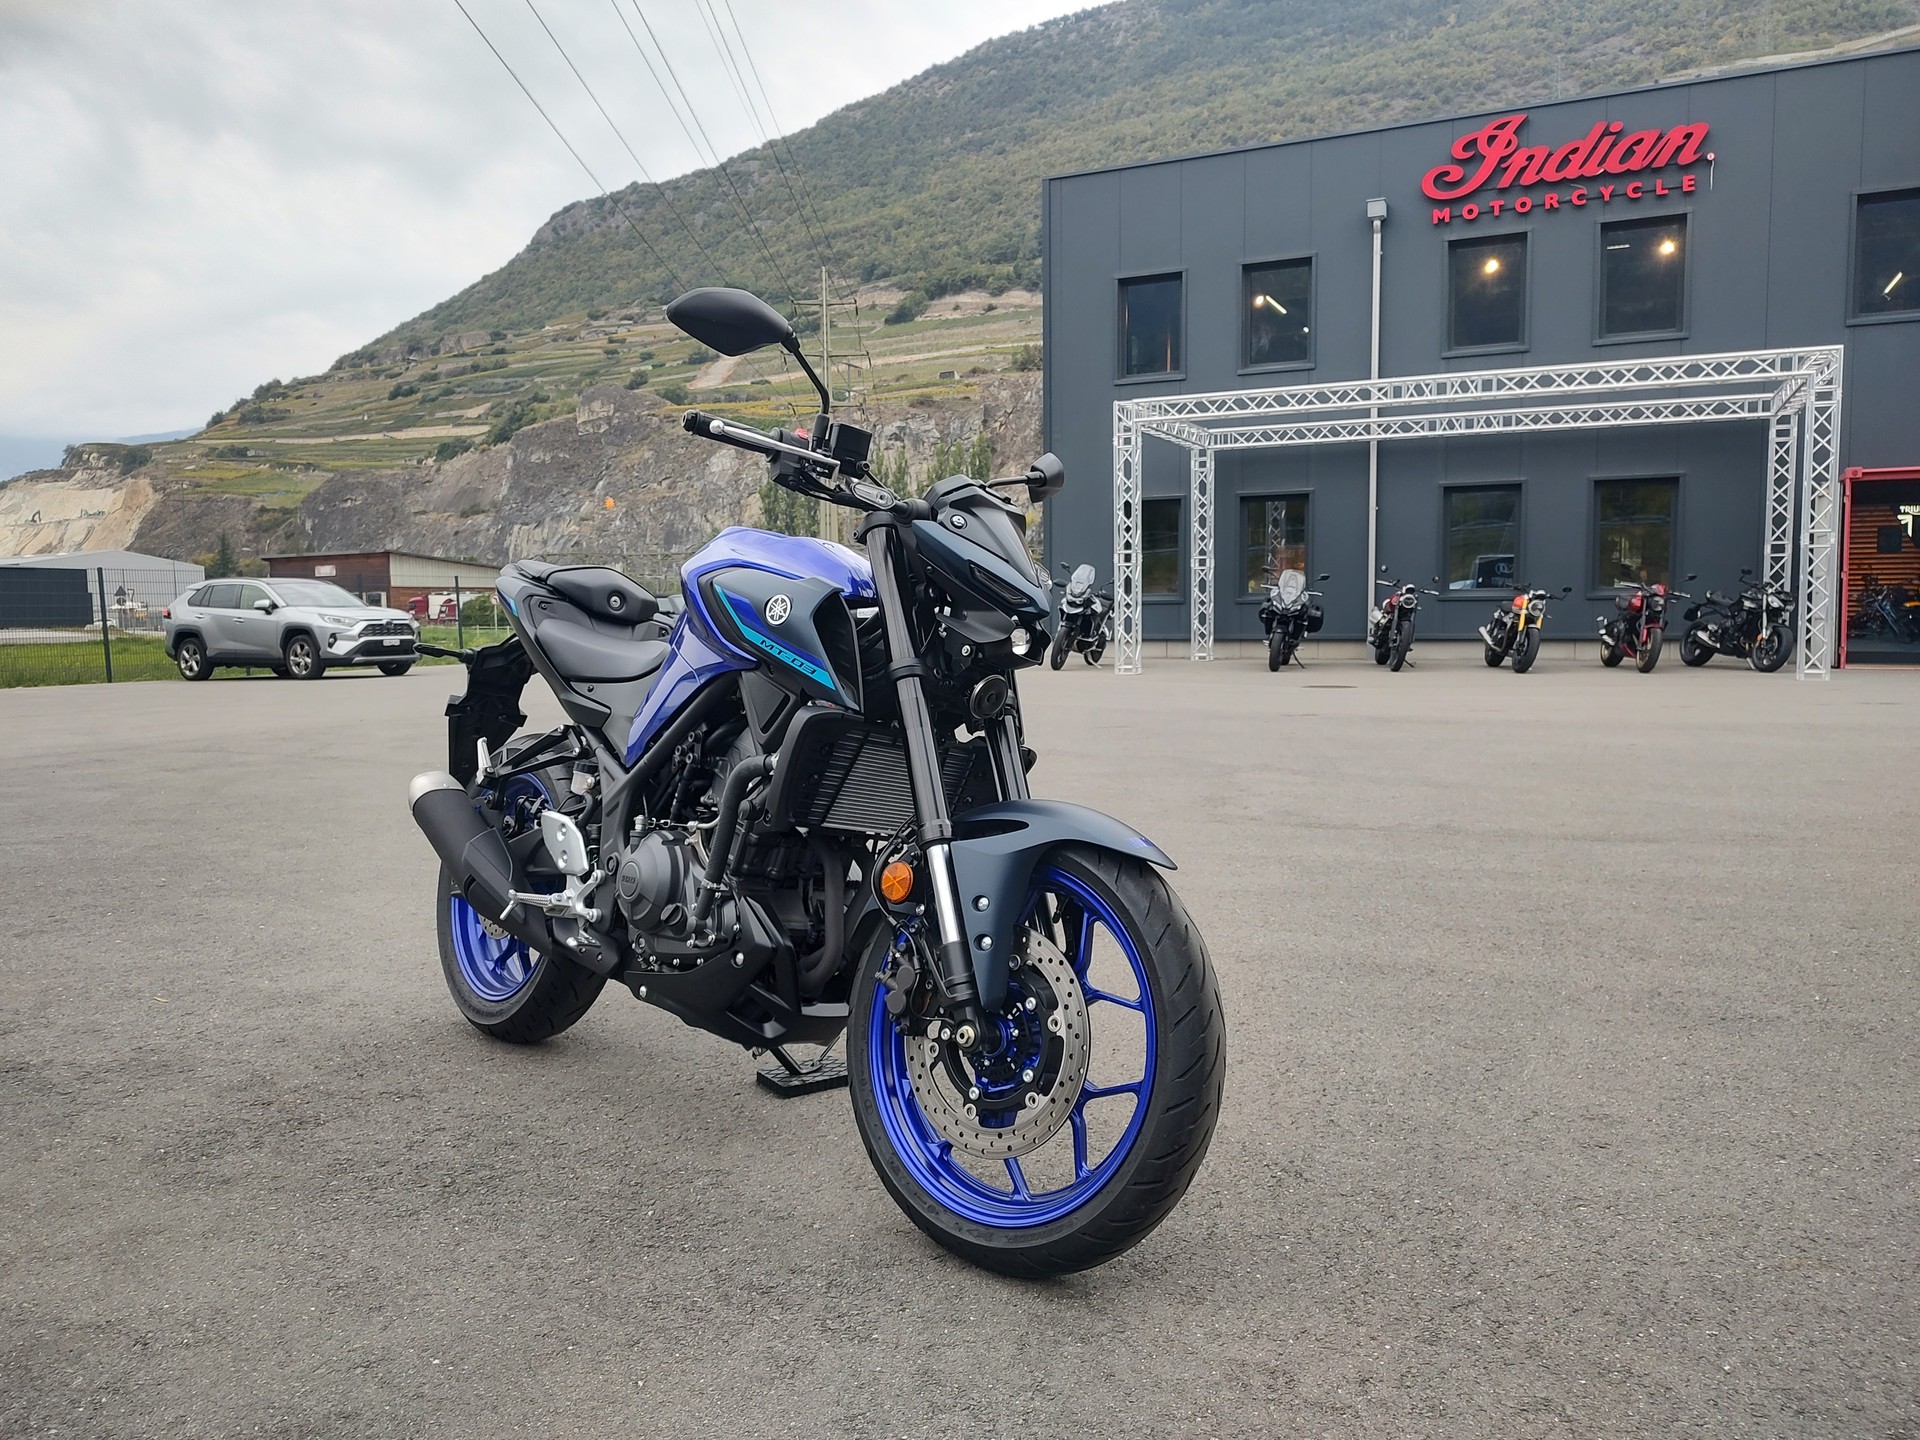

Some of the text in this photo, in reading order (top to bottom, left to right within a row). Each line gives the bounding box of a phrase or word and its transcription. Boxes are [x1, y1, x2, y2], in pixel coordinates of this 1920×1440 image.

[1421, 113, 1710, 200] Indian
[1431, 174, 1696, 224] MOTORCYCLE
[1899, 505, 1920, 515] TRIU
[760, 639, 817, 675] MT-03
